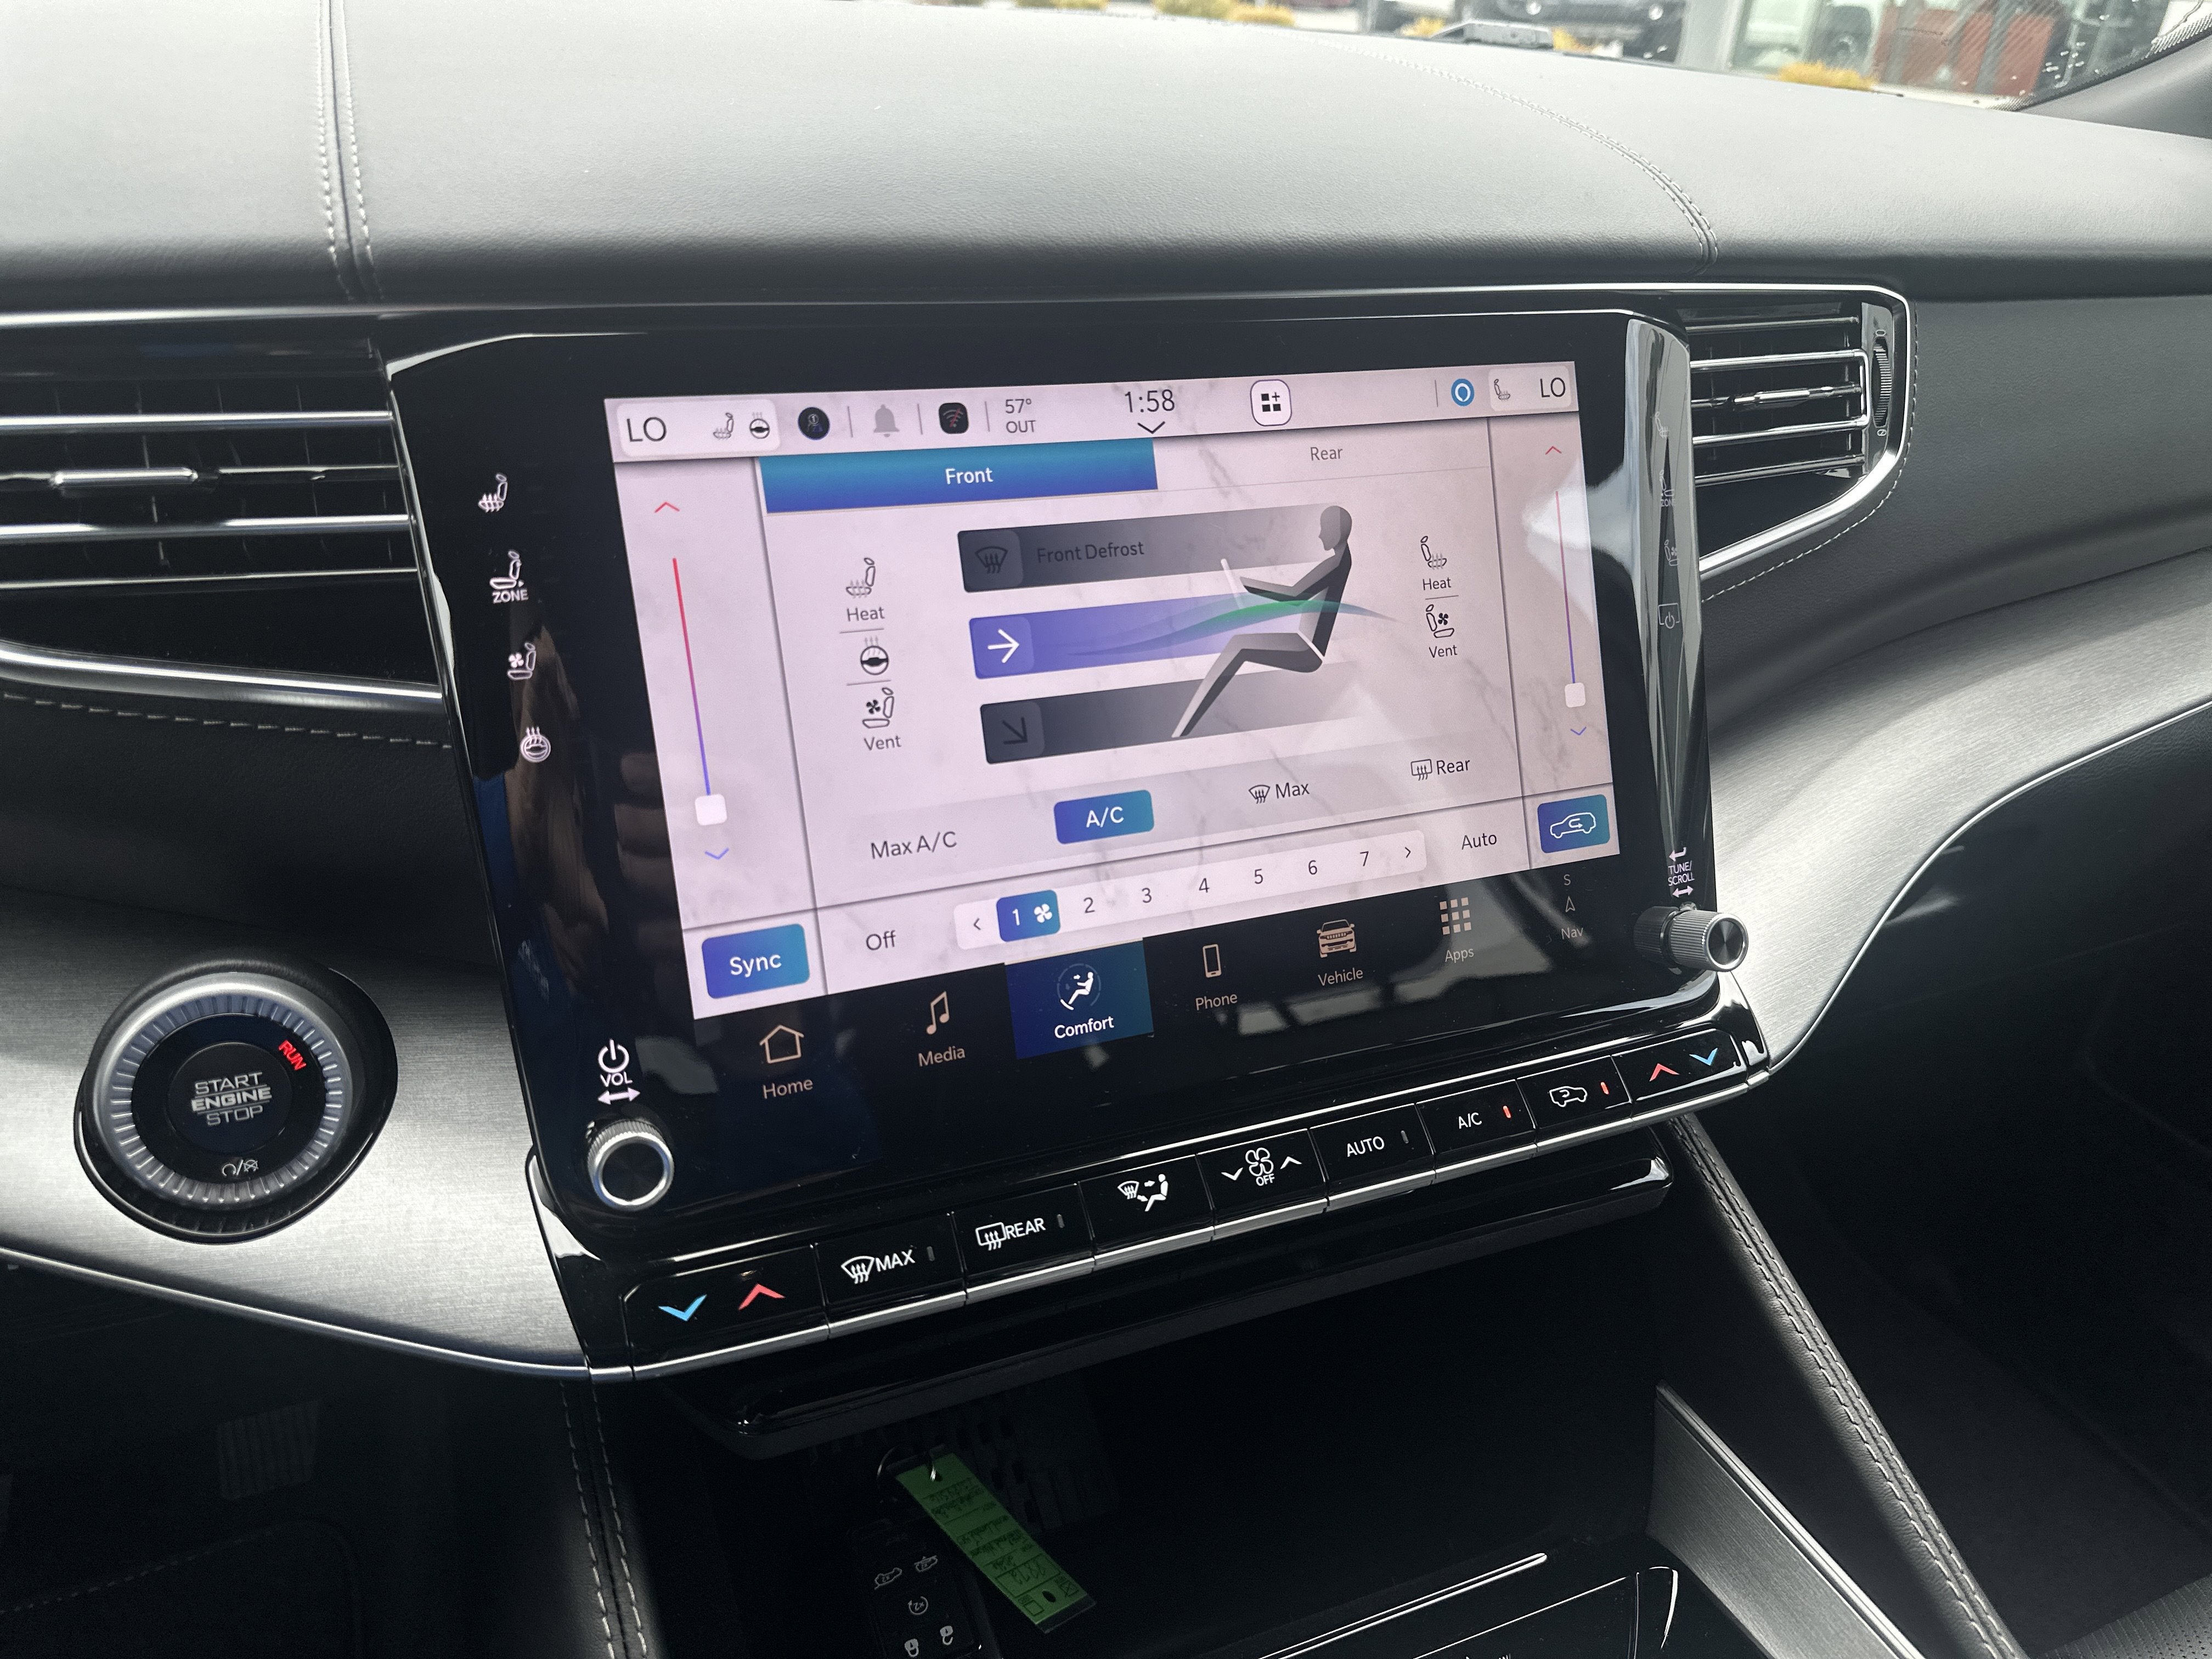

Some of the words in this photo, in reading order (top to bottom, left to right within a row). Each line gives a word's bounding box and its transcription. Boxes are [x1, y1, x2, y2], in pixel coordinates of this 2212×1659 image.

[1540, 377, 1566, 398] LO
[1005, 398, 1032, 414] 57°
[1125, 389, 1175, 413] 1:58
[627, 416, 667, 442] LO
[1006, 420, 1036, 433] OUT
[1310, 447, 1344, 461] Rear
[945, 467, 994, 484] Front
[1037, 546, 1082, 564] Front
[1085, 541, 1146, 560] Defrost
[1423, 577, 1452, 591] Heat
[493, 589, 529, 603] ZONE
[847, 606, 885, 622] Heat
[1429, 645, 1458, 658] Vent
[864, 735, 902, 751] Vent
[1436, 759, 1470, 775] Rear
[1276, 782, 1310, 799] Max
[1086, 806, 1124, 828] A/C
[871, 840, 912, 859] Max
[917, 831, 957, 853] A/C
[1462, 833, 1497, 850] Auto
[1668, 860, 1692, 875] TUNE/
[1564, 874, 1571, 886] S
[1667, 872, 1695, 887] SCROLL
[1012, 909, 1020, 926] 1
[1084, 897, 1095, 913] 2
[1142, 887, 1152, 904] 3
[1199, 878, 1210, 893] 4
[1254, 868, 1263, 884] 5
[1308, 860, 1318, 875] 6
[1359, 851, 1369, 867] 7
[866, 930, 896, 951] Off
[1561, 927, 1584, 940] Nav
[1444, 946, 1475, 963] Apps
[730, 955, 782, 978] Sync
[1318, 967, 1363, 986] Vehicle
[1195, 994, 1238, 1011] Phone
[1054, 1016, 1115, 1039] Comfort
[278, 1040, 307, 1071] RUN
[918, 1046, 966, 1067] Media
[194, 1071, 263, 1095] START
[600, 1071, 633, 1087] VOL
[763, 1079, 813, 1099] Home
[190, 1086, 273, 1112] ENGINE
[205, 1104, 263, 1126] STOP
[1458, 1112, 1482, 1129] A/C
[1347, 1136, 1385, 1158] AUTO
[1255, 1173, 1276, 1187] OFF
[1005, 1217, 1046, 1240] REAR
[875, 1249, 916, 1272] MAX
